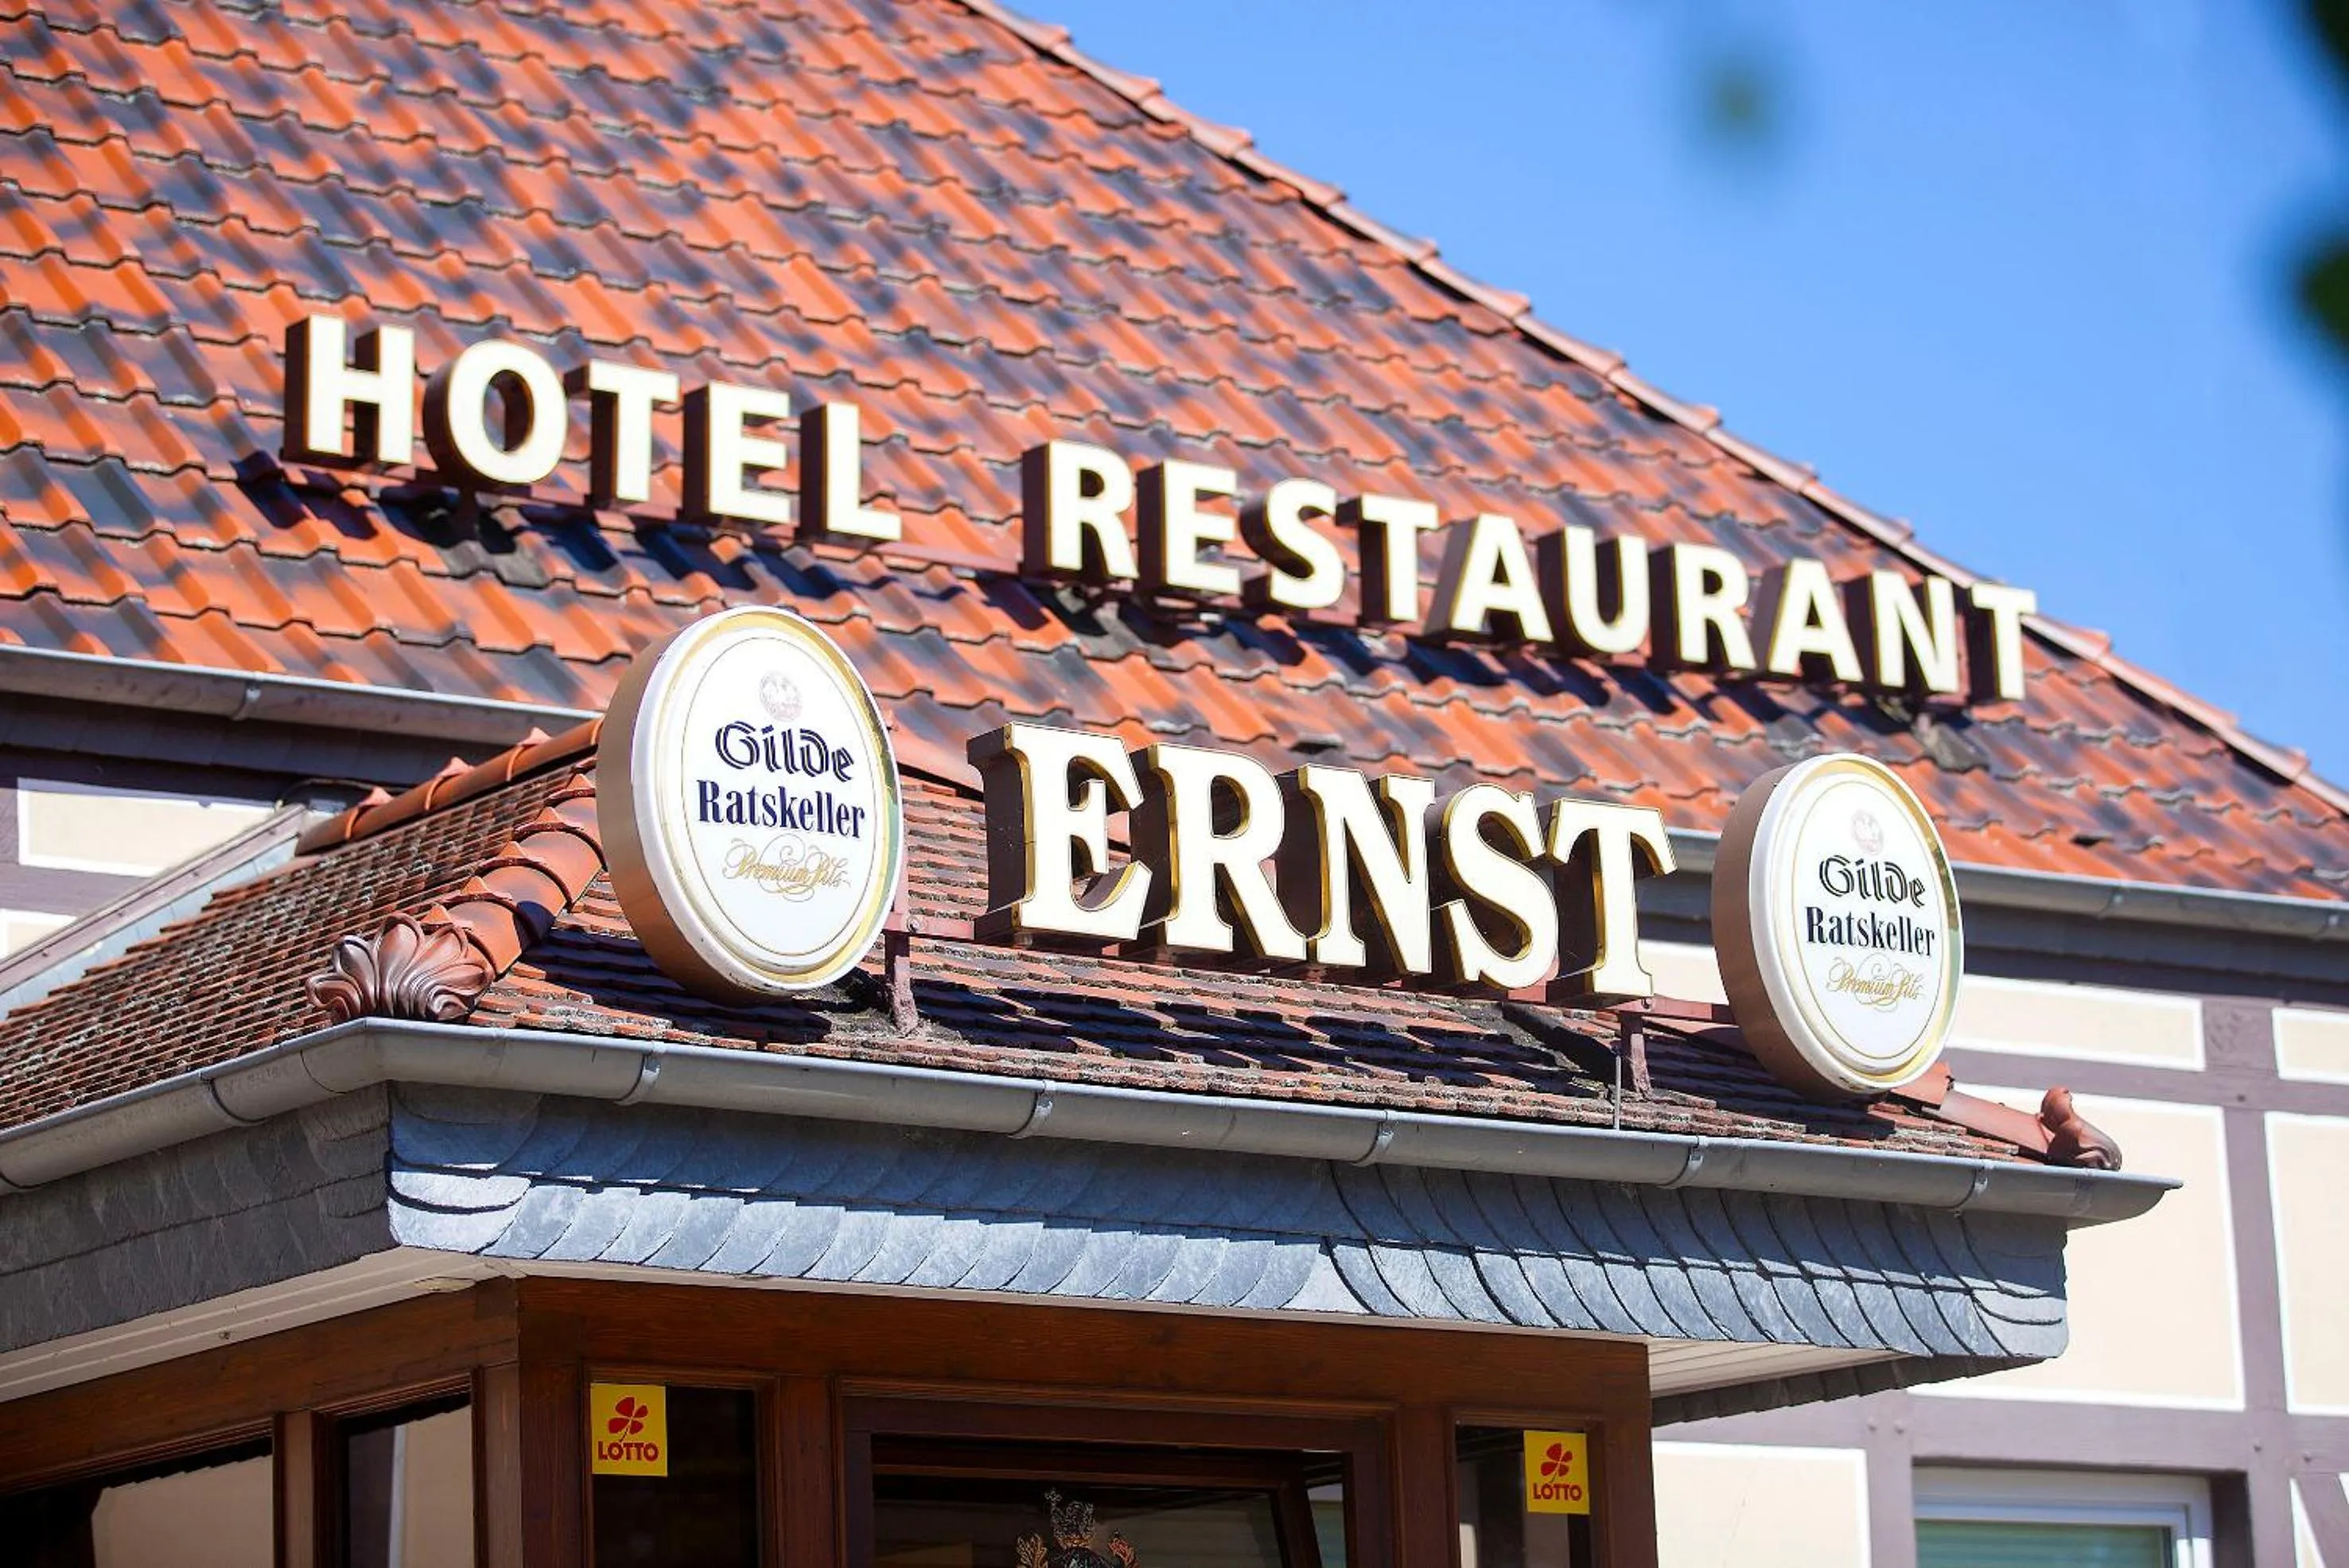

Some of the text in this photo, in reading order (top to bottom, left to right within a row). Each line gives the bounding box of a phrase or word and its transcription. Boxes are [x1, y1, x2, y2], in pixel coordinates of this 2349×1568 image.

[305, 313, 2038, 701] HOTEL RESTAURANT
[715, 721, 854, 783] Gilde
[696, 779, 865, 839] Ratskeller
[721, 838, 810, 888] Premium
[1004, 722, 1679, 998] ERNST
[1818, 854, 1926, 909] Gilde
[1804, 906, 1935, 957] Ratskeller
[1826, 957, 1894, 1002] Premium
[597, 1440, 659, 1461] LOTTO
[1532, 1482, 1583, 1502] LOTTO
